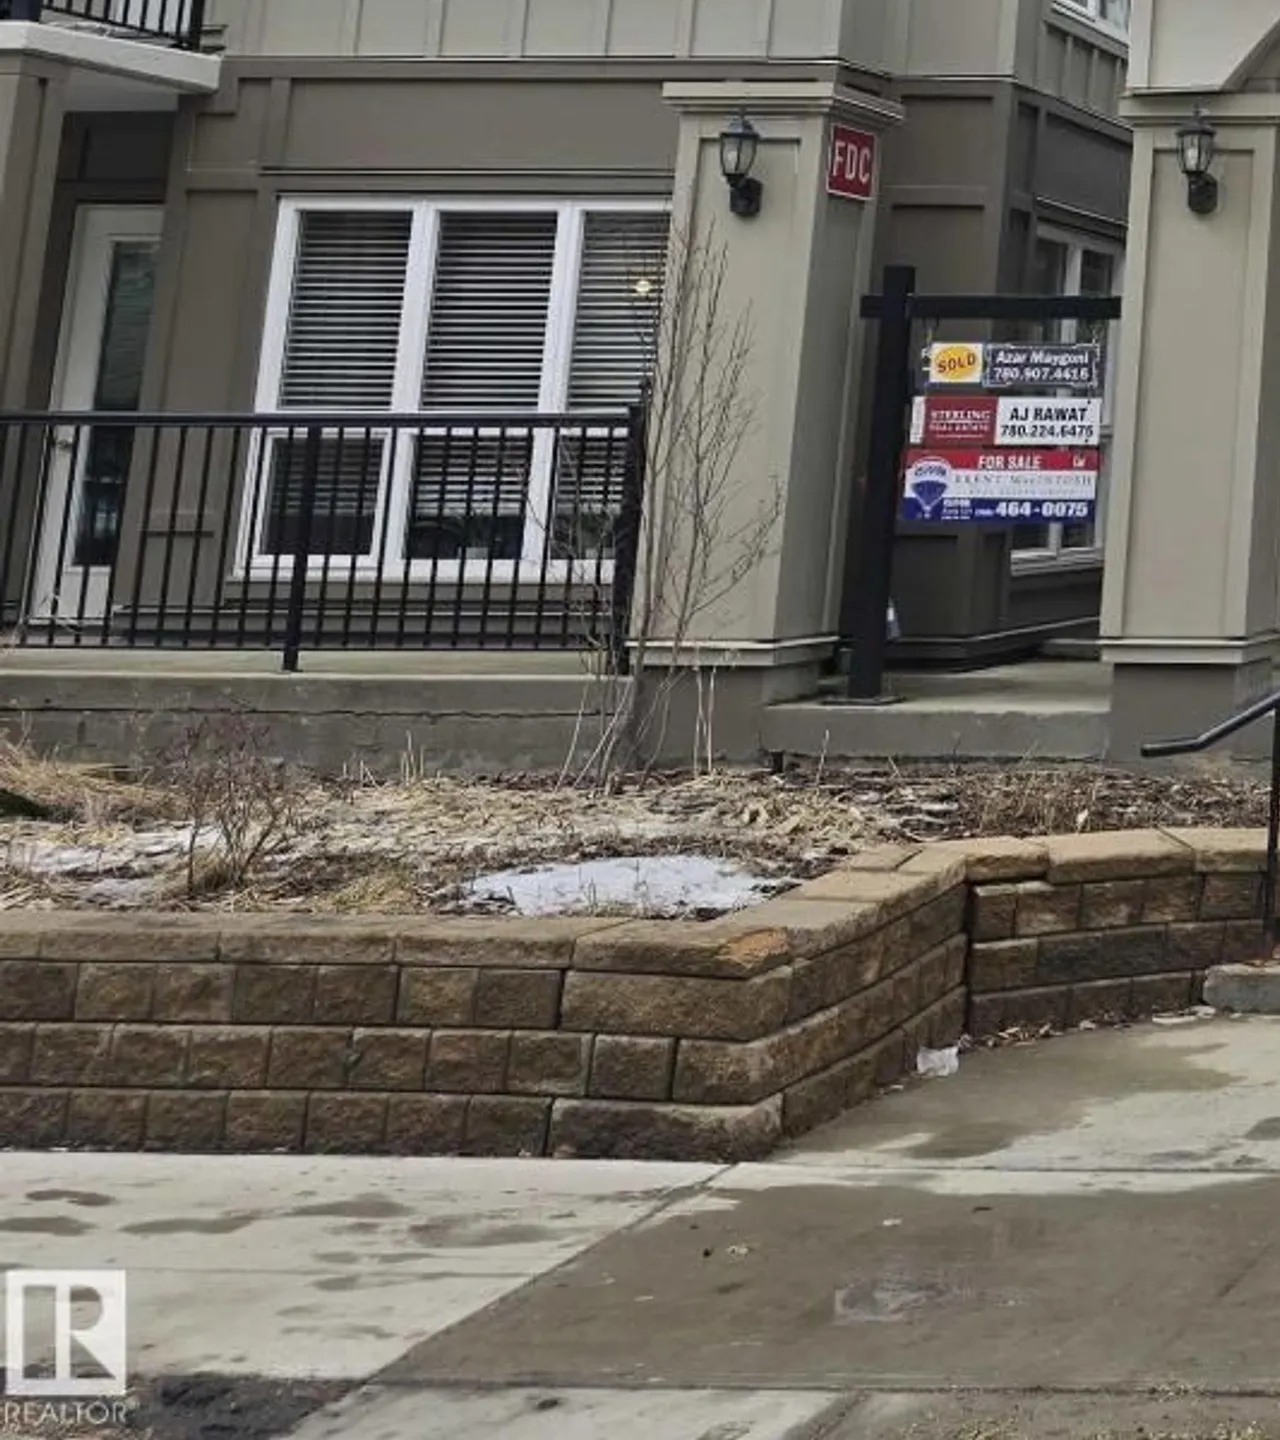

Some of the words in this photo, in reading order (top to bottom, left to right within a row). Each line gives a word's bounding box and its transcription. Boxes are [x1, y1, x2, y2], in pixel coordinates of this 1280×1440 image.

[832, 140, 871, 184] FDC
[937, 352, 976, 373] SOLD
[1010, 407, 1029, 421] AJ
[1033, 407, 1087, 421] RAWAT
[978, 455, 1004, 469] FOR
[1008, 455, 1042, 469] SALE
